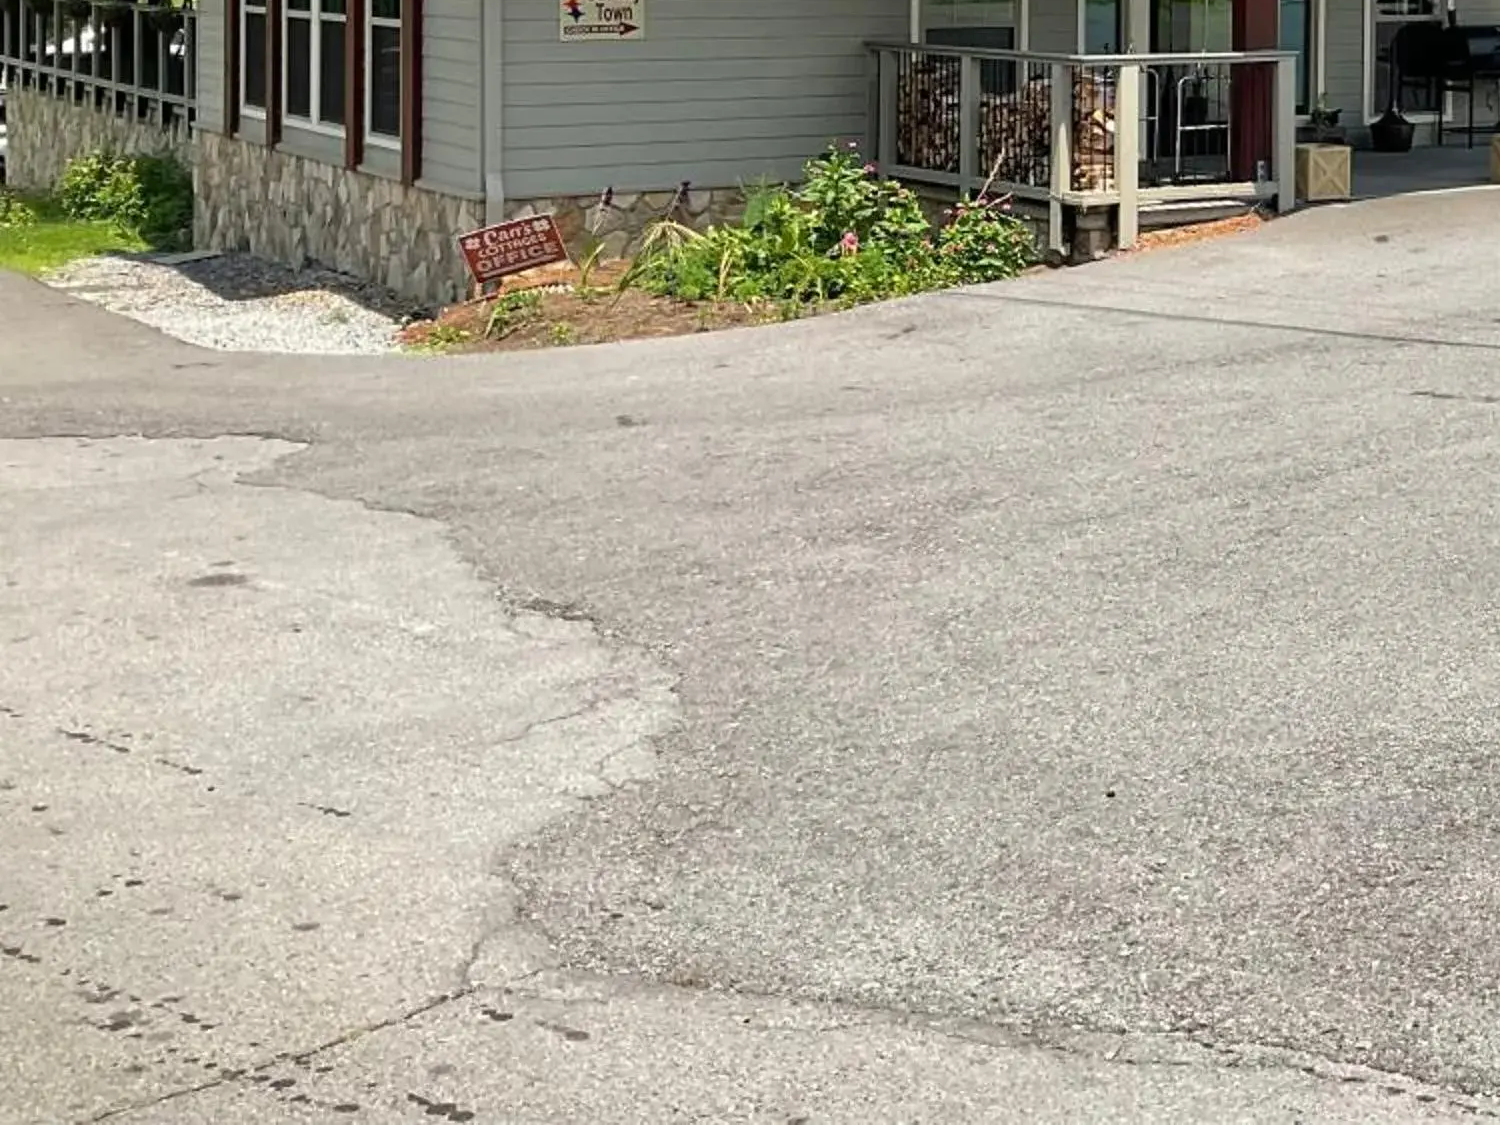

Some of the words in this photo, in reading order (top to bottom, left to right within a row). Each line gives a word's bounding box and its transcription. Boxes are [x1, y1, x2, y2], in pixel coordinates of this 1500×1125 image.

[596, 3, 633, 22] Town
[476, 242, 559, 272] OFFICE
[477, 233, 548, 258] COTTAGES
